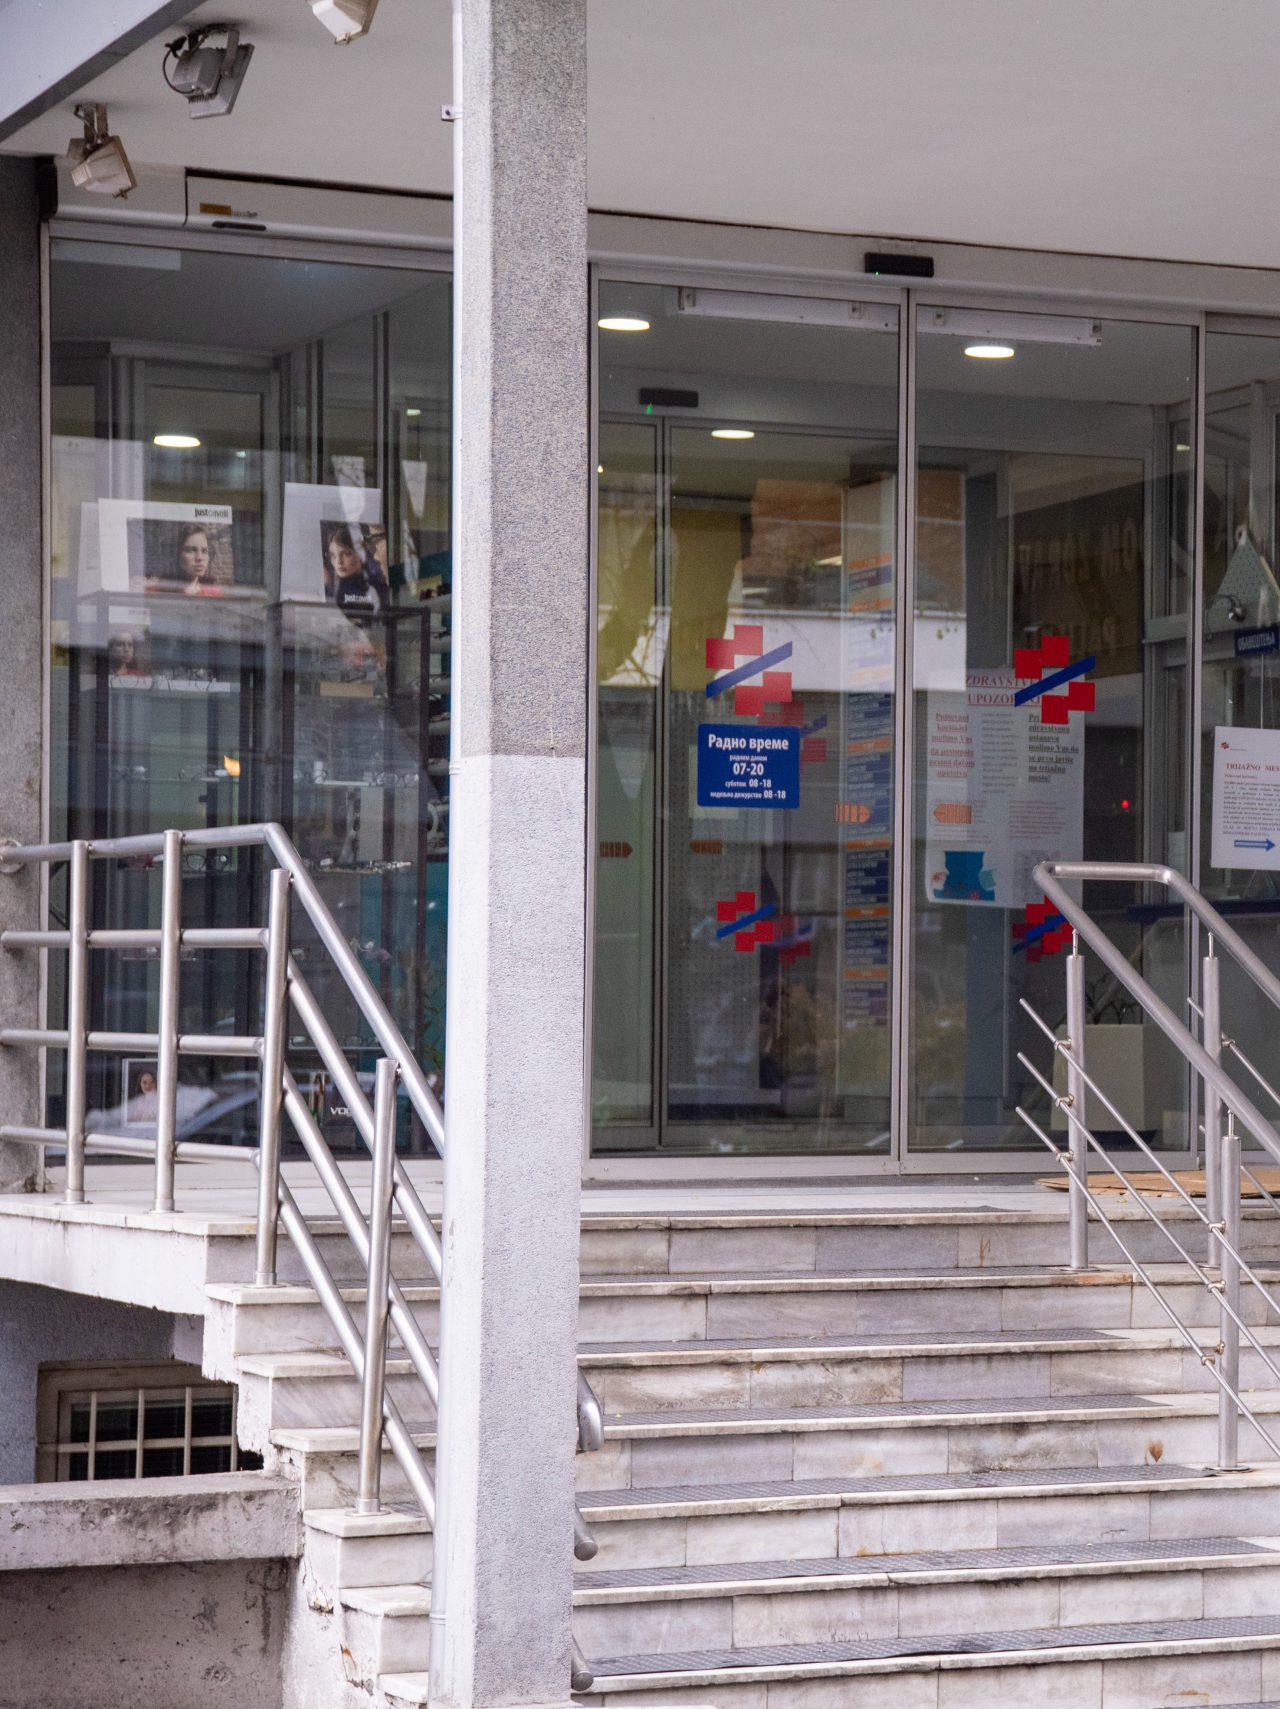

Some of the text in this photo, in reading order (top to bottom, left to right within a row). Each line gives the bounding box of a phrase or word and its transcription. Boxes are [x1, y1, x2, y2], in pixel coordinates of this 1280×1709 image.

[708, 733, 789, 752] Радно време
[733, 763, 764, 775] 07-20
[1226, 762, 1261, 770] TRIJAŽNO
